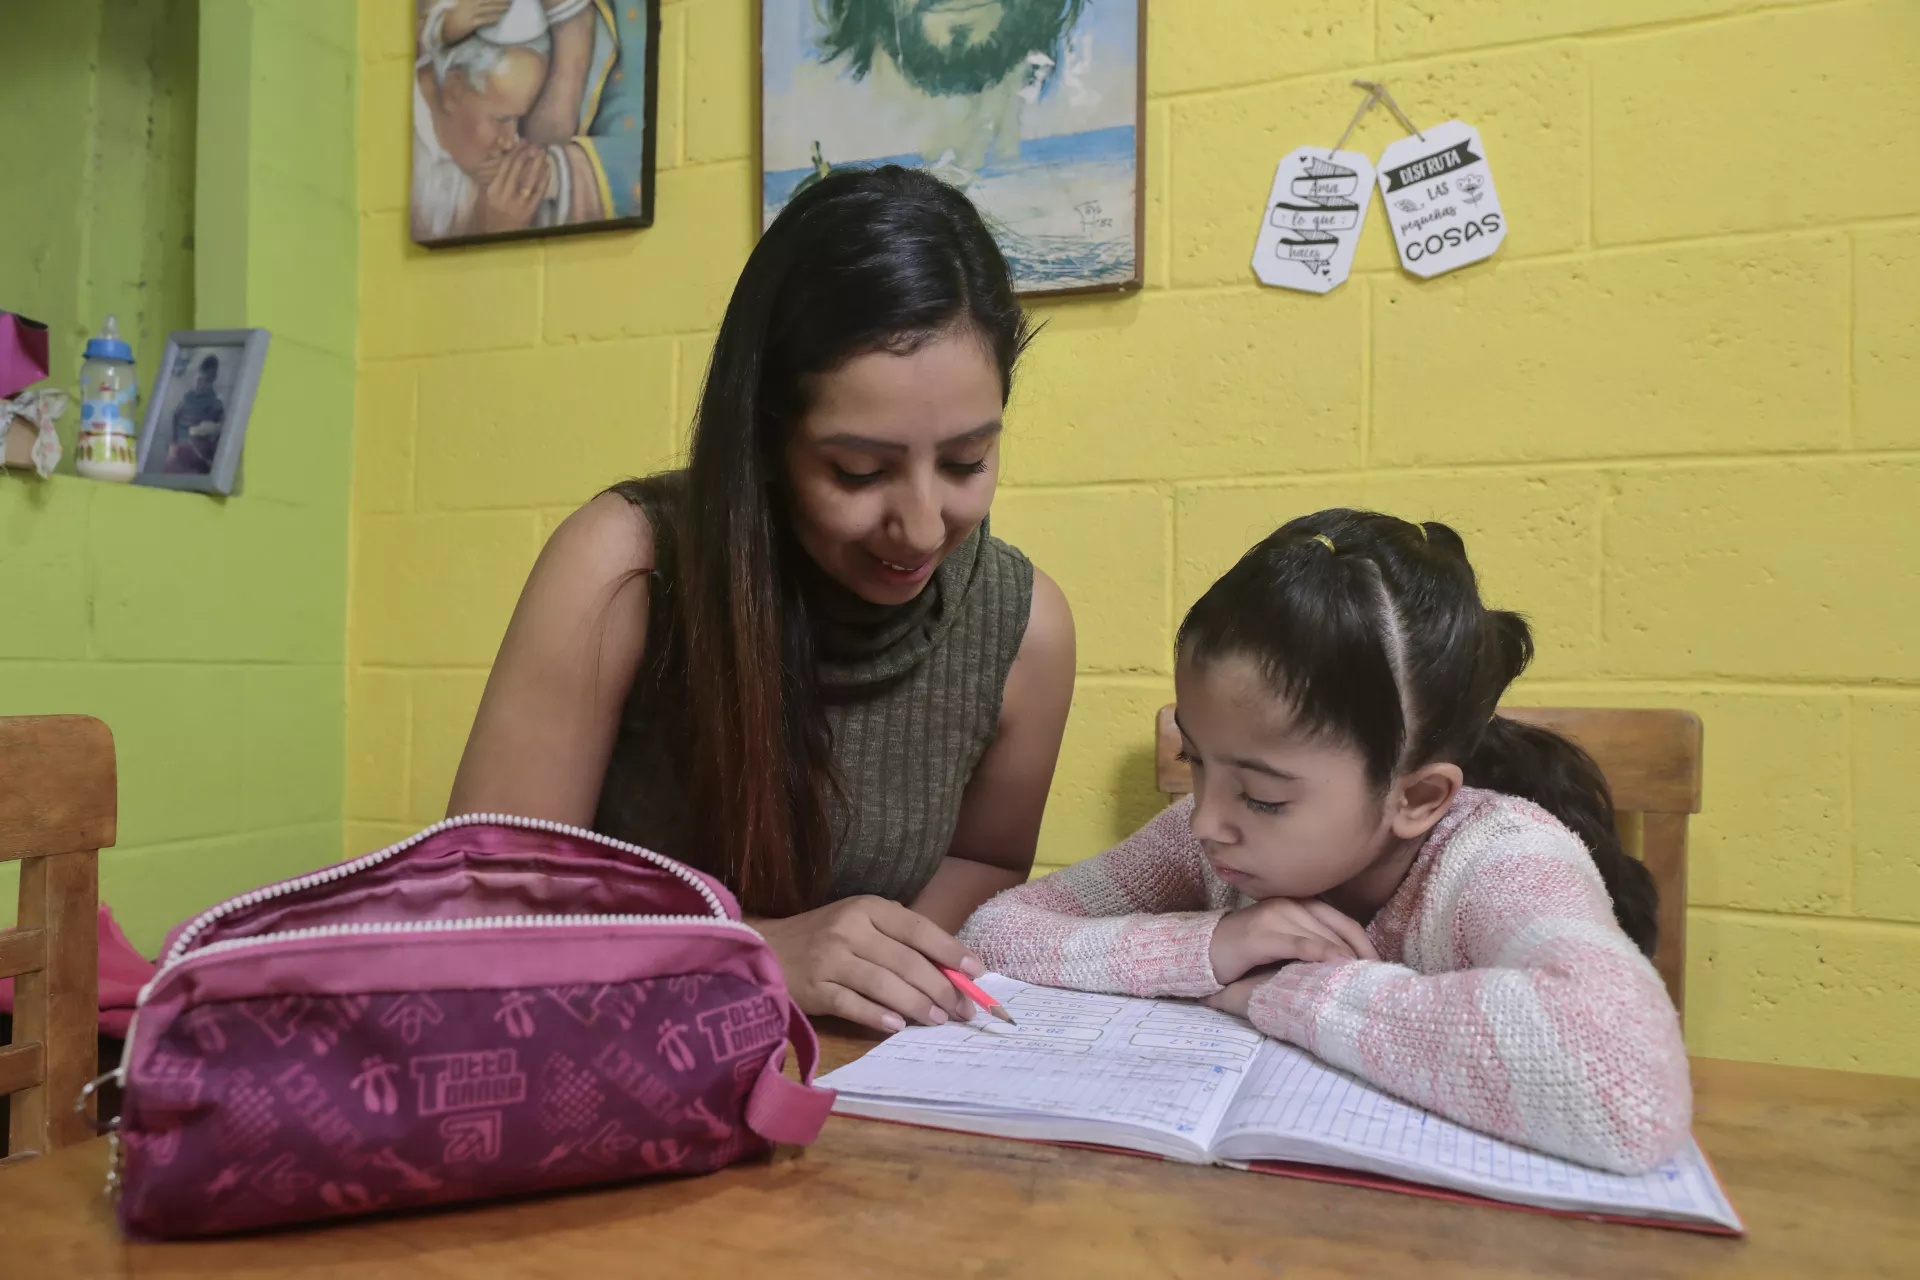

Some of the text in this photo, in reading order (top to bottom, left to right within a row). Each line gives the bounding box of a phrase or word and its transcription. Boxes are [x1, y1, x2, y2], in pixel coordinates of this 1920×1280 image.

[1400, 149, 1462, 185] DISFRUTA
[1426, 181, 1450, 201] LAS
[1313, 214, 1336, 231] que
[1401, 205, 1457, 236] pequeñas
[1406, 212, 1501, 262] COSAS
